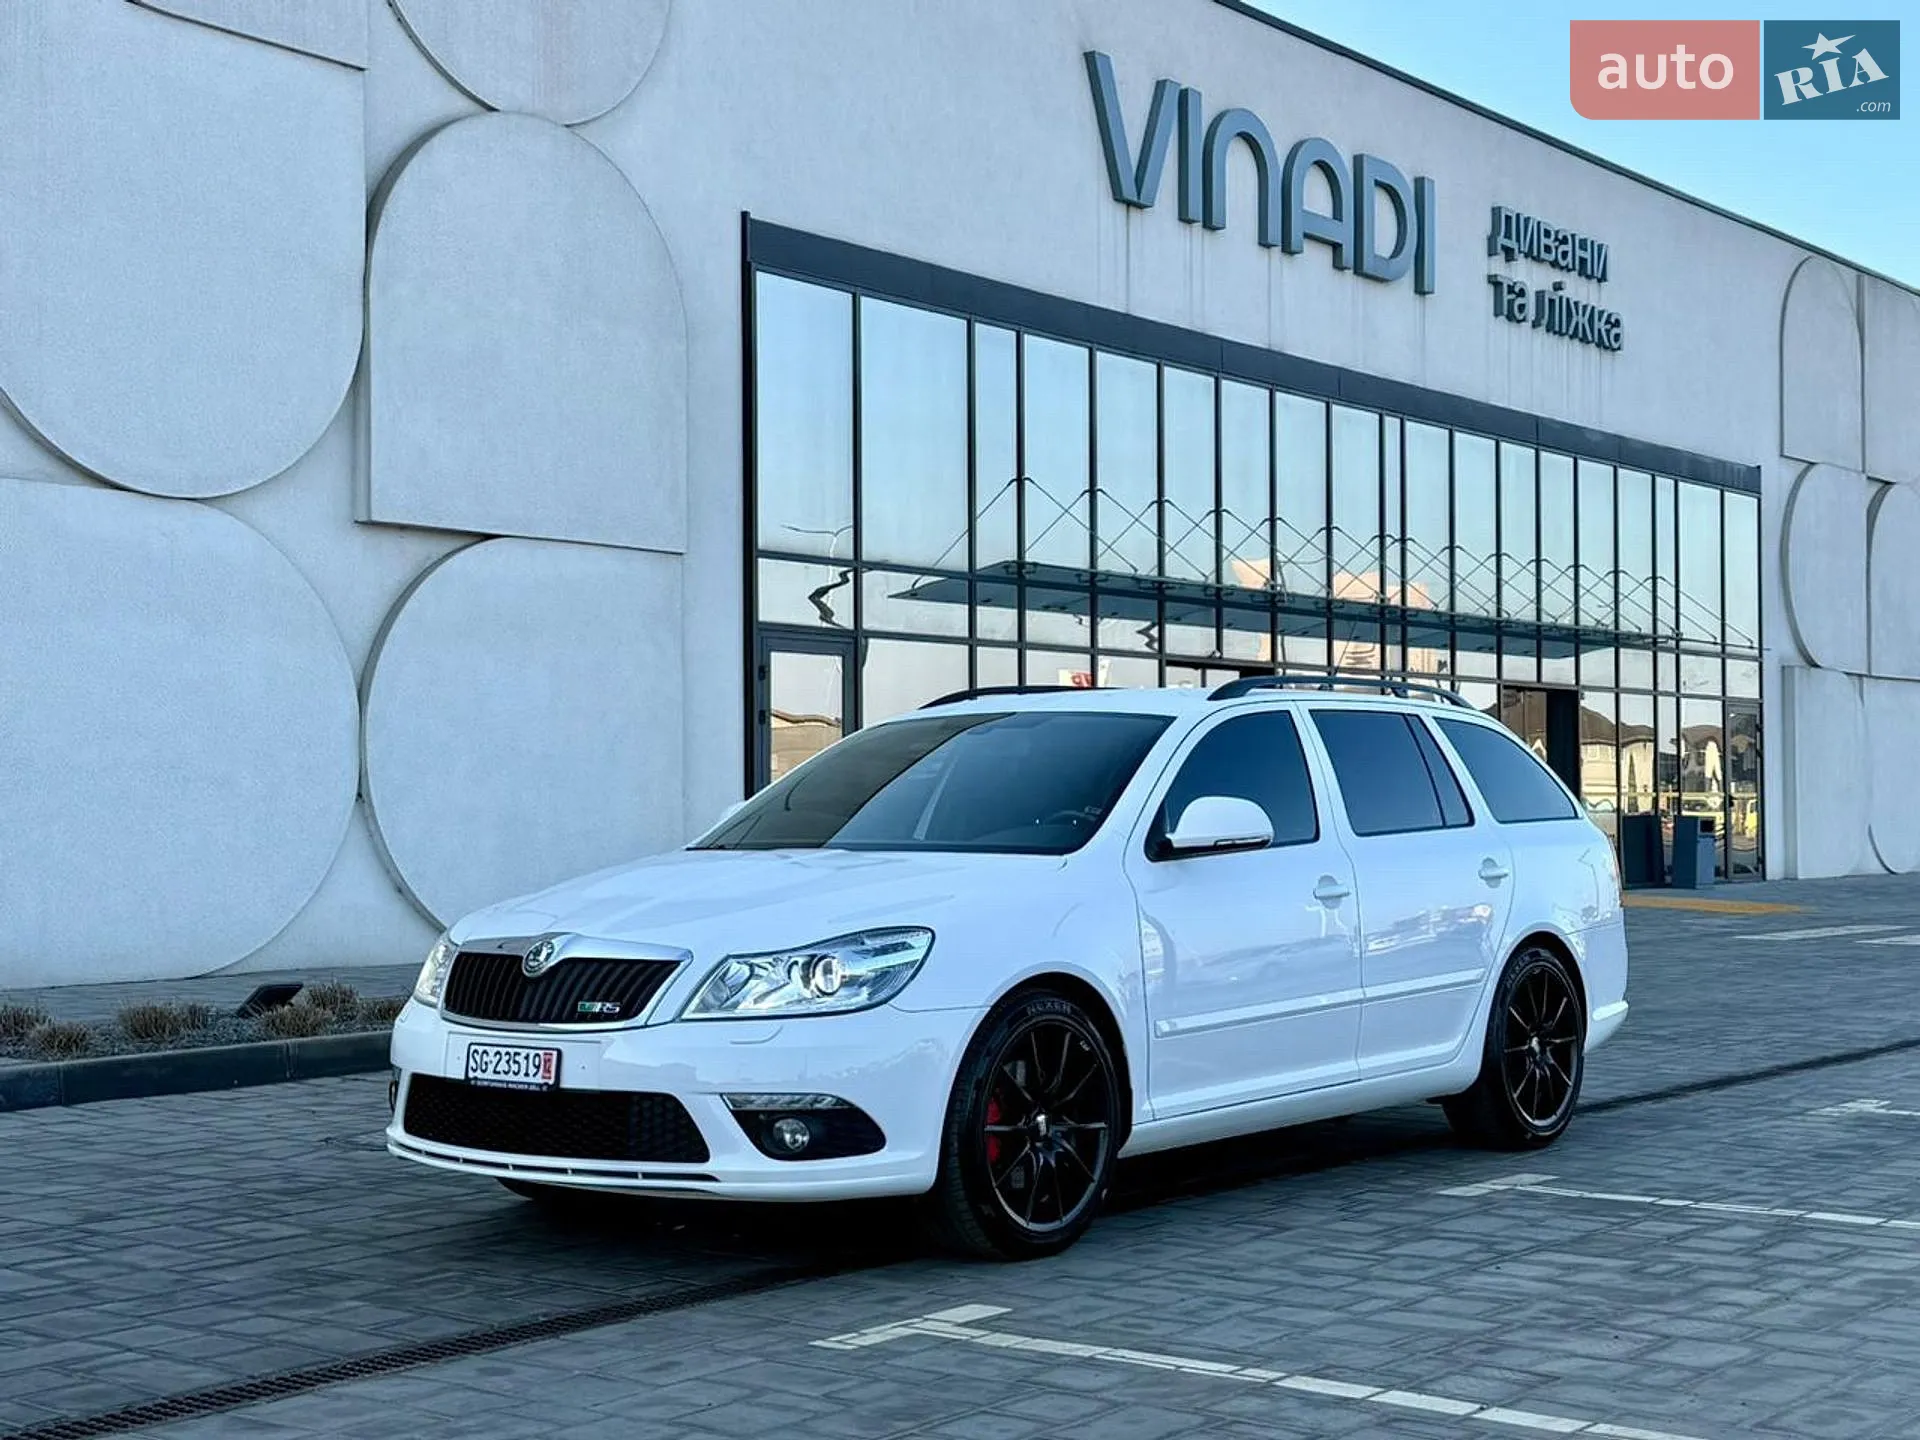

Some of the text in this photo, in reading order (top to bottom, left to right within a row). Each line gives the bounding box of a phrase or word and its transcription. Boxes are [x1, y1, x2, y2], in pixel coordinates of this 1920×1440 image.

[1084, 50, 1436, 295] VINADI
[1487, 205, 1609, 282] дивани
[1487, 274, 1624, 351] та ліжка
